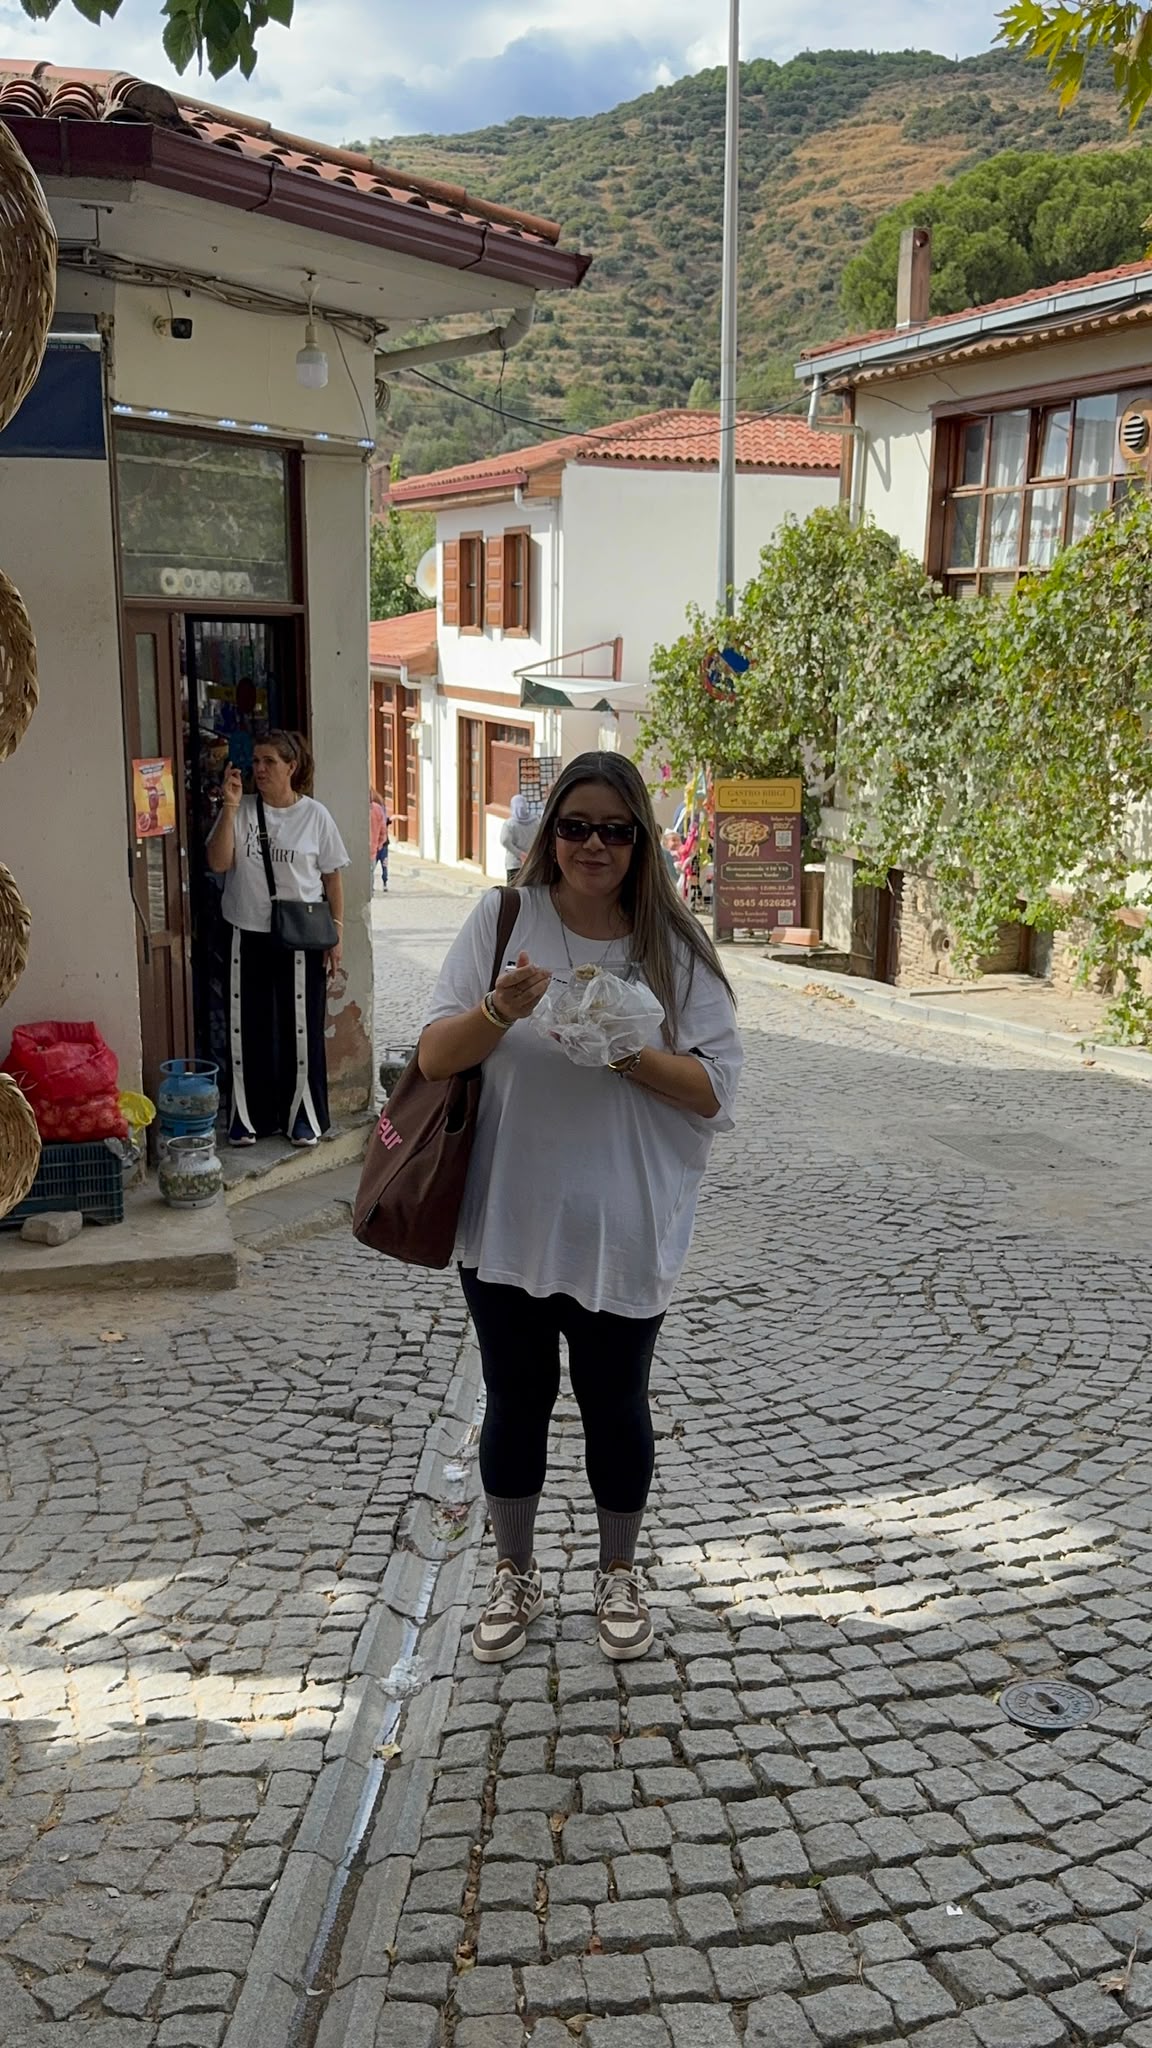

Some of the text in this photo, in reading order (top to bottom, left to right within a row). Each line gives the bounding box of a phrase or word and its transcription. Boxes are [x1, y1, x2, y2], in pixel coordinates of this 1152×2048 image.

[727, 789, 761, 797] GASTRO
[733, 898, 797, 907] 0545 4526254
